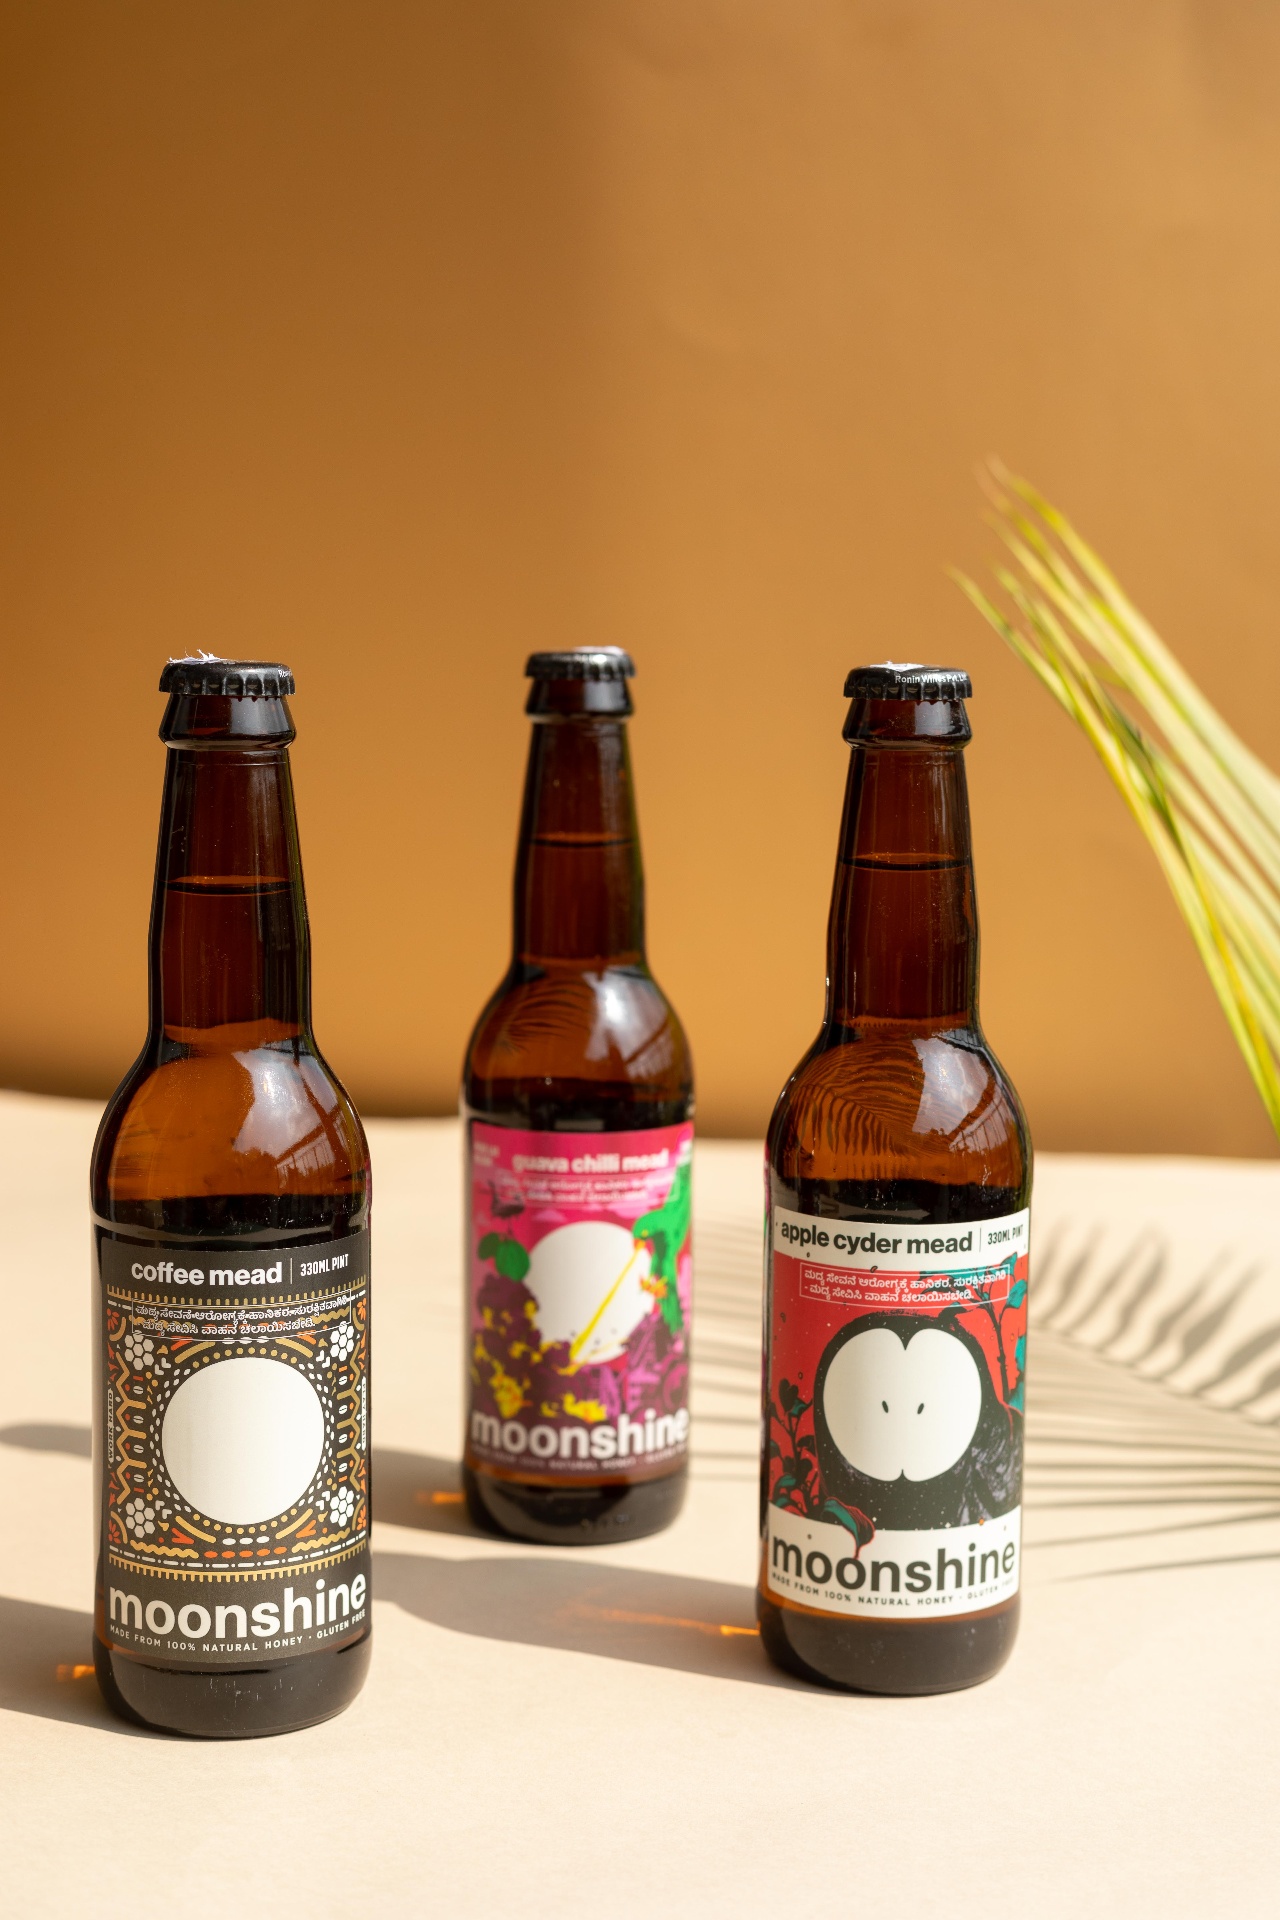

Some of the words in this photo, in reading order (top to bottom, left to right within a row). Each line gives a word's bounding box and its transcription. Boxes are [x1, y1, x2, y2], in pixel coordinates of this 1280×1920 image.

[895, 675, 920, 683] Ronin
[512, 1154, 569, 1173] guava
[571, 1153, 620, 1173] chilli
[622, 1148, 669, 1172] mead
[781, 1221, 830, 1247] apple
[833, 1233, 902, 1255] cyder
[907, 1231, 973, 1254] mead
[988, 1231, 1011, 1246] 330ML
[1012, 1224, 1024, 1240] PINT
[131, 1261, 204, 1285] coffee
[209, 1261, 283, 1286] mead
[300, 1259, 330, 1277] 330ML
[332, 1253, 350, 1271] PINT
[471, 1408, 689, 1460] moonshine
[772, 1535, 1015, 1593] moonshine
[109, 1573, 366, 1638] moonshine
[772, 1571, 790, 1587] MADE
[795, 1582, 819, 1596] FROM
[824, 1591, 852, 1602] 100%
[858, 1596, 910, 1606] NATURAL
[917, 1595, 953, 1606] HONEY
[110, 1624, 130, 1639] MADE
[135, 1634, 161, 1647] FROM
[167, 1640, 196, 1651] 100%
[203, 1643, 258, 1652] NATURAL
[265, 1636, 303, 1650] HONEY
[317, 1620, 349, 1639] GLUTEN
[352, 1610, 366, 1625] FREE
